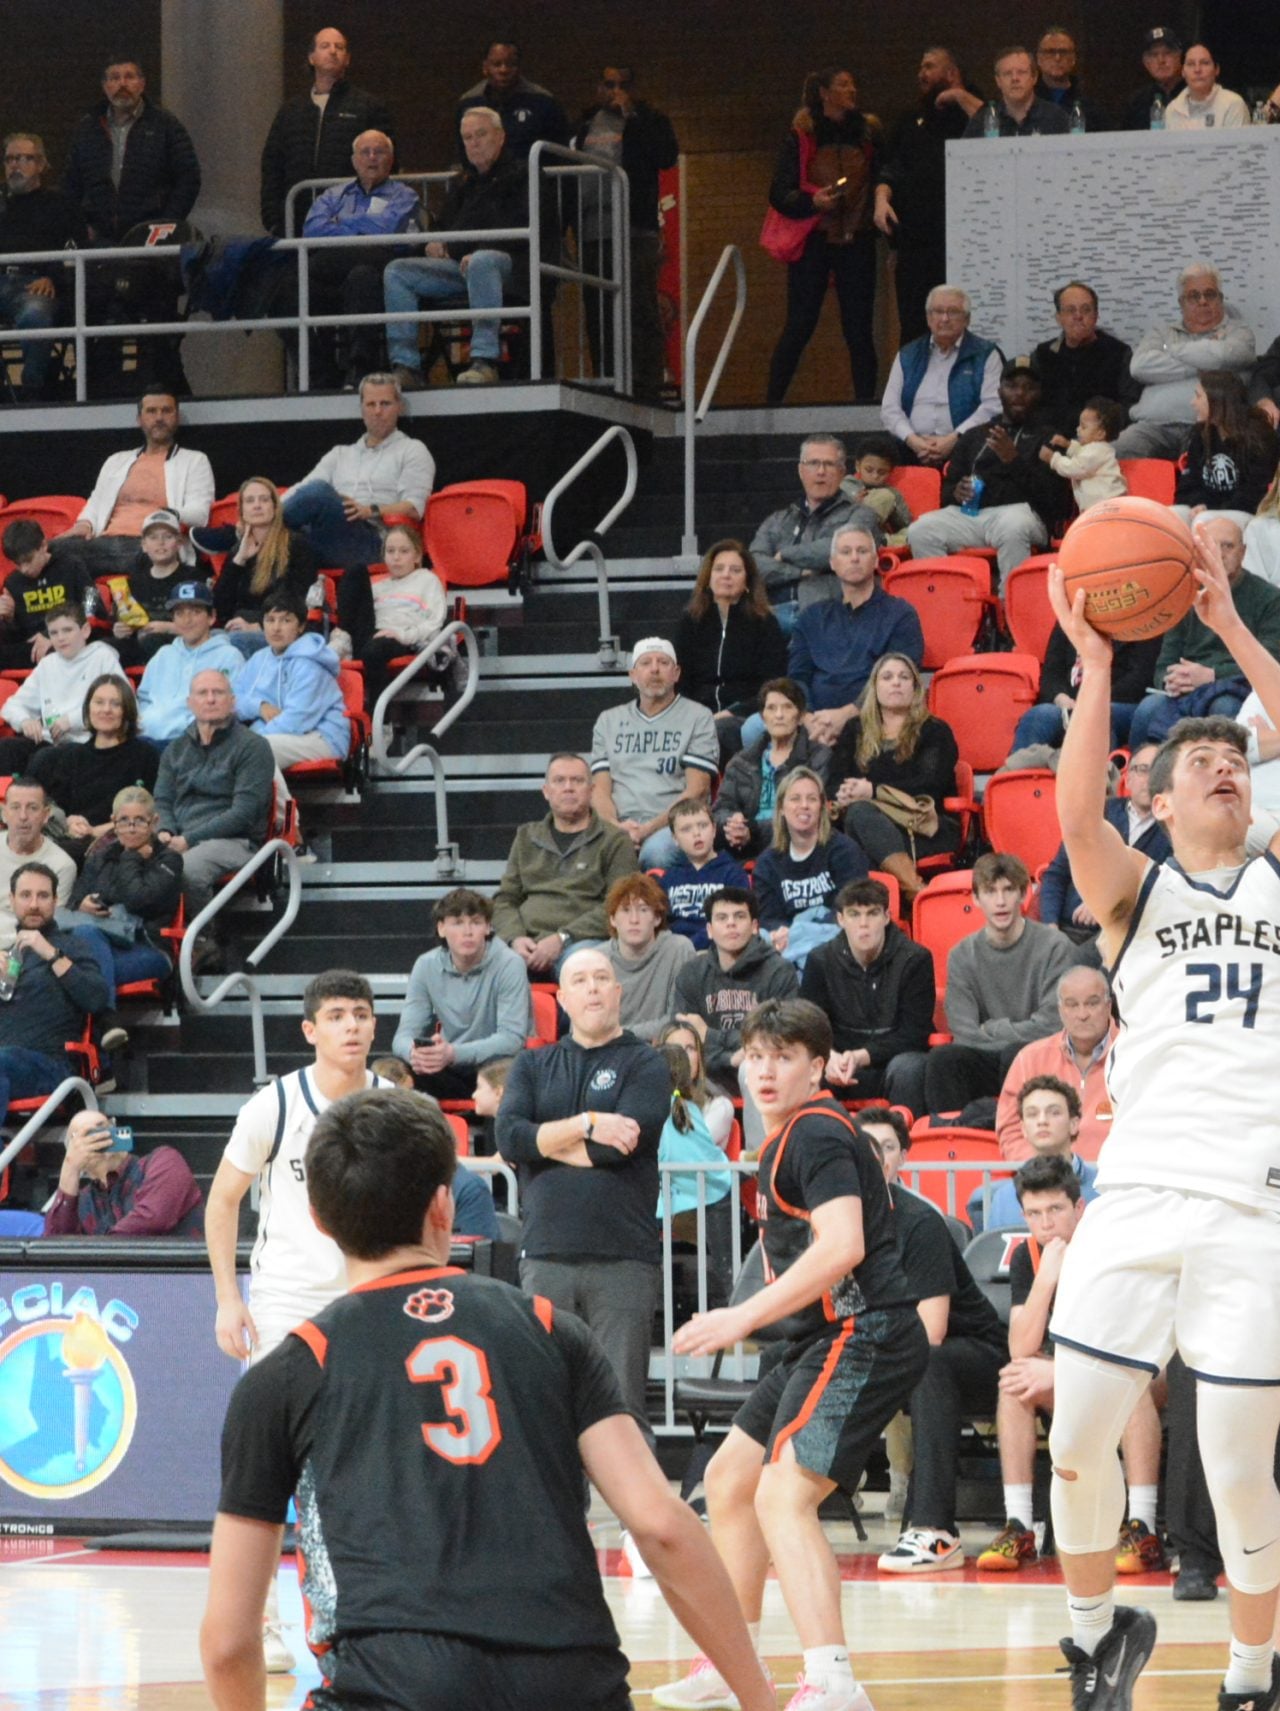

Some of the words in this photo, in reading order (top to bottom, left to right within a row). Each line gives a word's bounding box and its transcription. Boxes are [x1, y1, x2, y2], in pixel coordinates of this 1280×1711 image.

[179, 584, 195, 599] G
[1090, 587, 1151, 613] LEGAC
[613, 730, 682, 754] STAPLES
[655, 756, 678, 775] 30
[781, 871, 836, 902] ESTPOR
[1185, 963, 1263, 1029] 24
[0, 1282, 139, 1342] CIAC
[405, 1335, 502, 1466] 3
[0, 1523, 54, 1535] TRONICS
